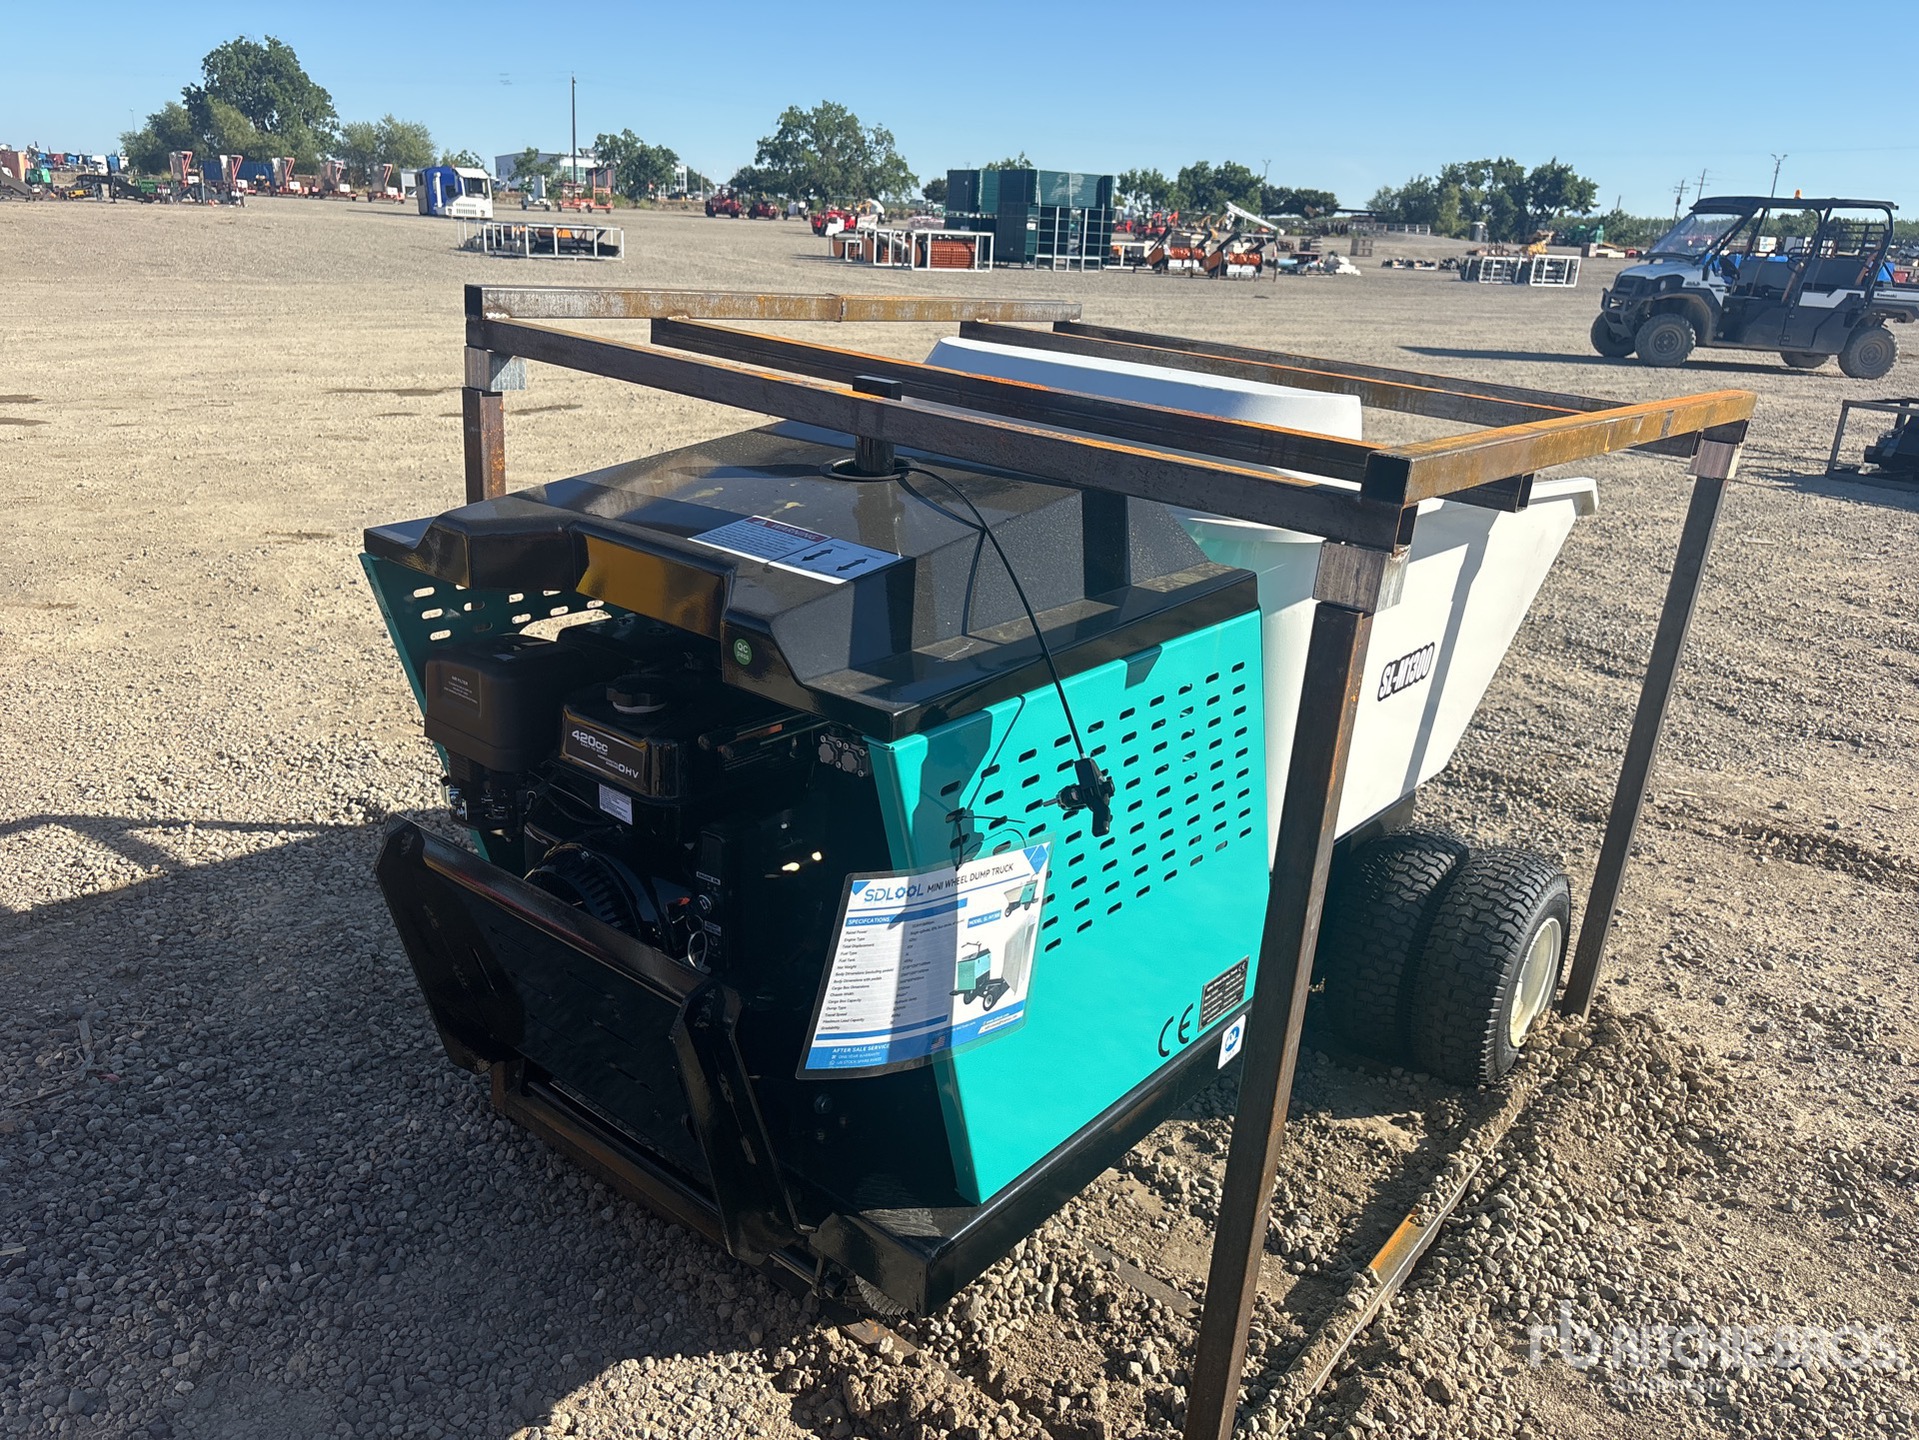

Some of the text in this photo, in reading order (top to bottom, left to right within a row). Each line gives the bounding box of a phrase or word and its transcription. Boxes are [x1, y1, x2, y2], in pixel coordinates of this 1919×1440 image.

[738, 642, 748, 653] QC
[572, 730, 608, 752] 420cc
[618, 764, 639, 778] OHV
[926, 882, 944, 893] MINI
[945, 875, 968, 888] WHEEL
[970, 869, 990, 883] DUMP
[991, 863, 1014, 877] TRUCK
